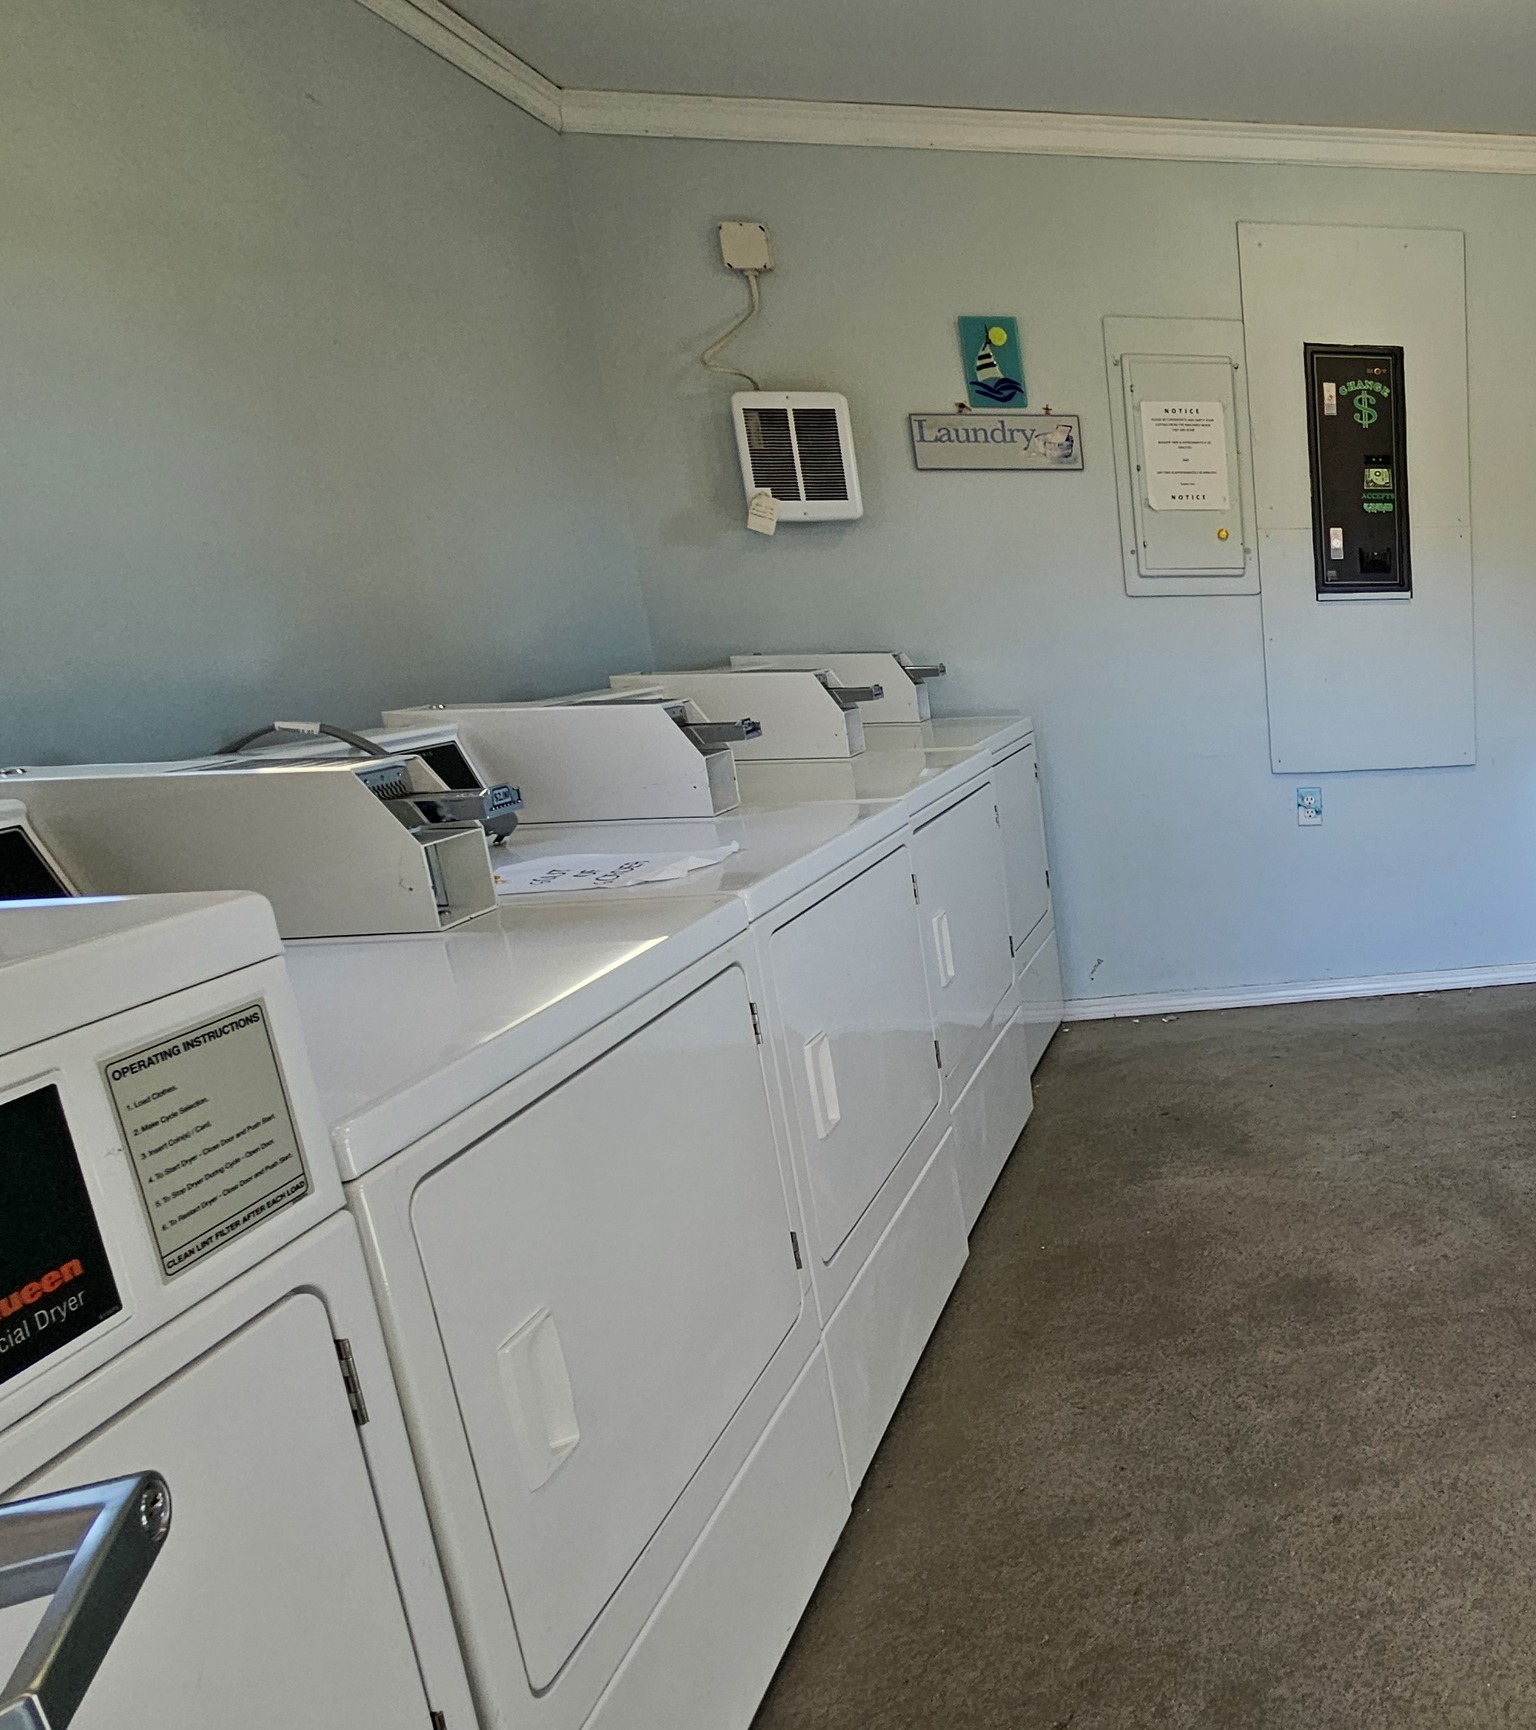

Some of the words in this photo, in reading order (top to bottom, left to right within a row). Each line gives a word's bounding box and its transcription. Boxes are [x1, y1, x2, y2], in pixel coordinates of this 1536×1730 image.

[1339, 380, 1390, 398] CHANGE
[1353, 390, 1378, 429] $
[913, 419, 1036, 451] Laundry
[112, 1045, 181, 1081] OPERATING
[183, 1012, 260, 1051] INSTRUCTIONS
[134, 1096, 151, 1108] Load
[151, 1085, 178, 1100] Clothes.
[141, 1120, 159, 1132] Make
[160, 1111, 178, 1125] Cycle
[179, 1096, 209, 1114] Selection.
[148, 1143, 167, 1157] Insert
[155, 1172, 164, 1180] To
[164, 1163, 181, 1176] Start
[181, 1155, 198, 1169] Dryer
[202, 1143, 220, 1155] Close
[220, 1135, 235, 1147] Door
[235, 1128, 247, 1139] and
[246, 1121, 261, 1134] Push
[162, 1195, 171, 1204] To
[171, 1187, 187, 1200] Stop
[187, 1178, 204, 1192] Dryer
[204, 1166, 225, 1181] During
[225, 1156, 242, 1171] Cycle
[245, 1146, 260, 1159] Open
[168, 1218, 178, 1227] To
[178, 1204, 201, 1221] Restart
[201, 1195, 218, 1210] Dryer
[222, 1184, 239, 1197] Close
[239, 1175, 253, 1188] Door
[253, 1168, 265, 1179] and
[264, 1160, 279, 1174] Push
[166, 1248, 195, 1269] CLEAN
[196, 1236, 214, 1252] LINT
[215, 1219, 242, 1241] FILTER
[242, 1205, 266, 1224] AFTER
[266, 1192, 286, 1209] EACH
[286, 1180, 306, 1198] LOAD
[34, 1290, 86, 1330] Dryer
